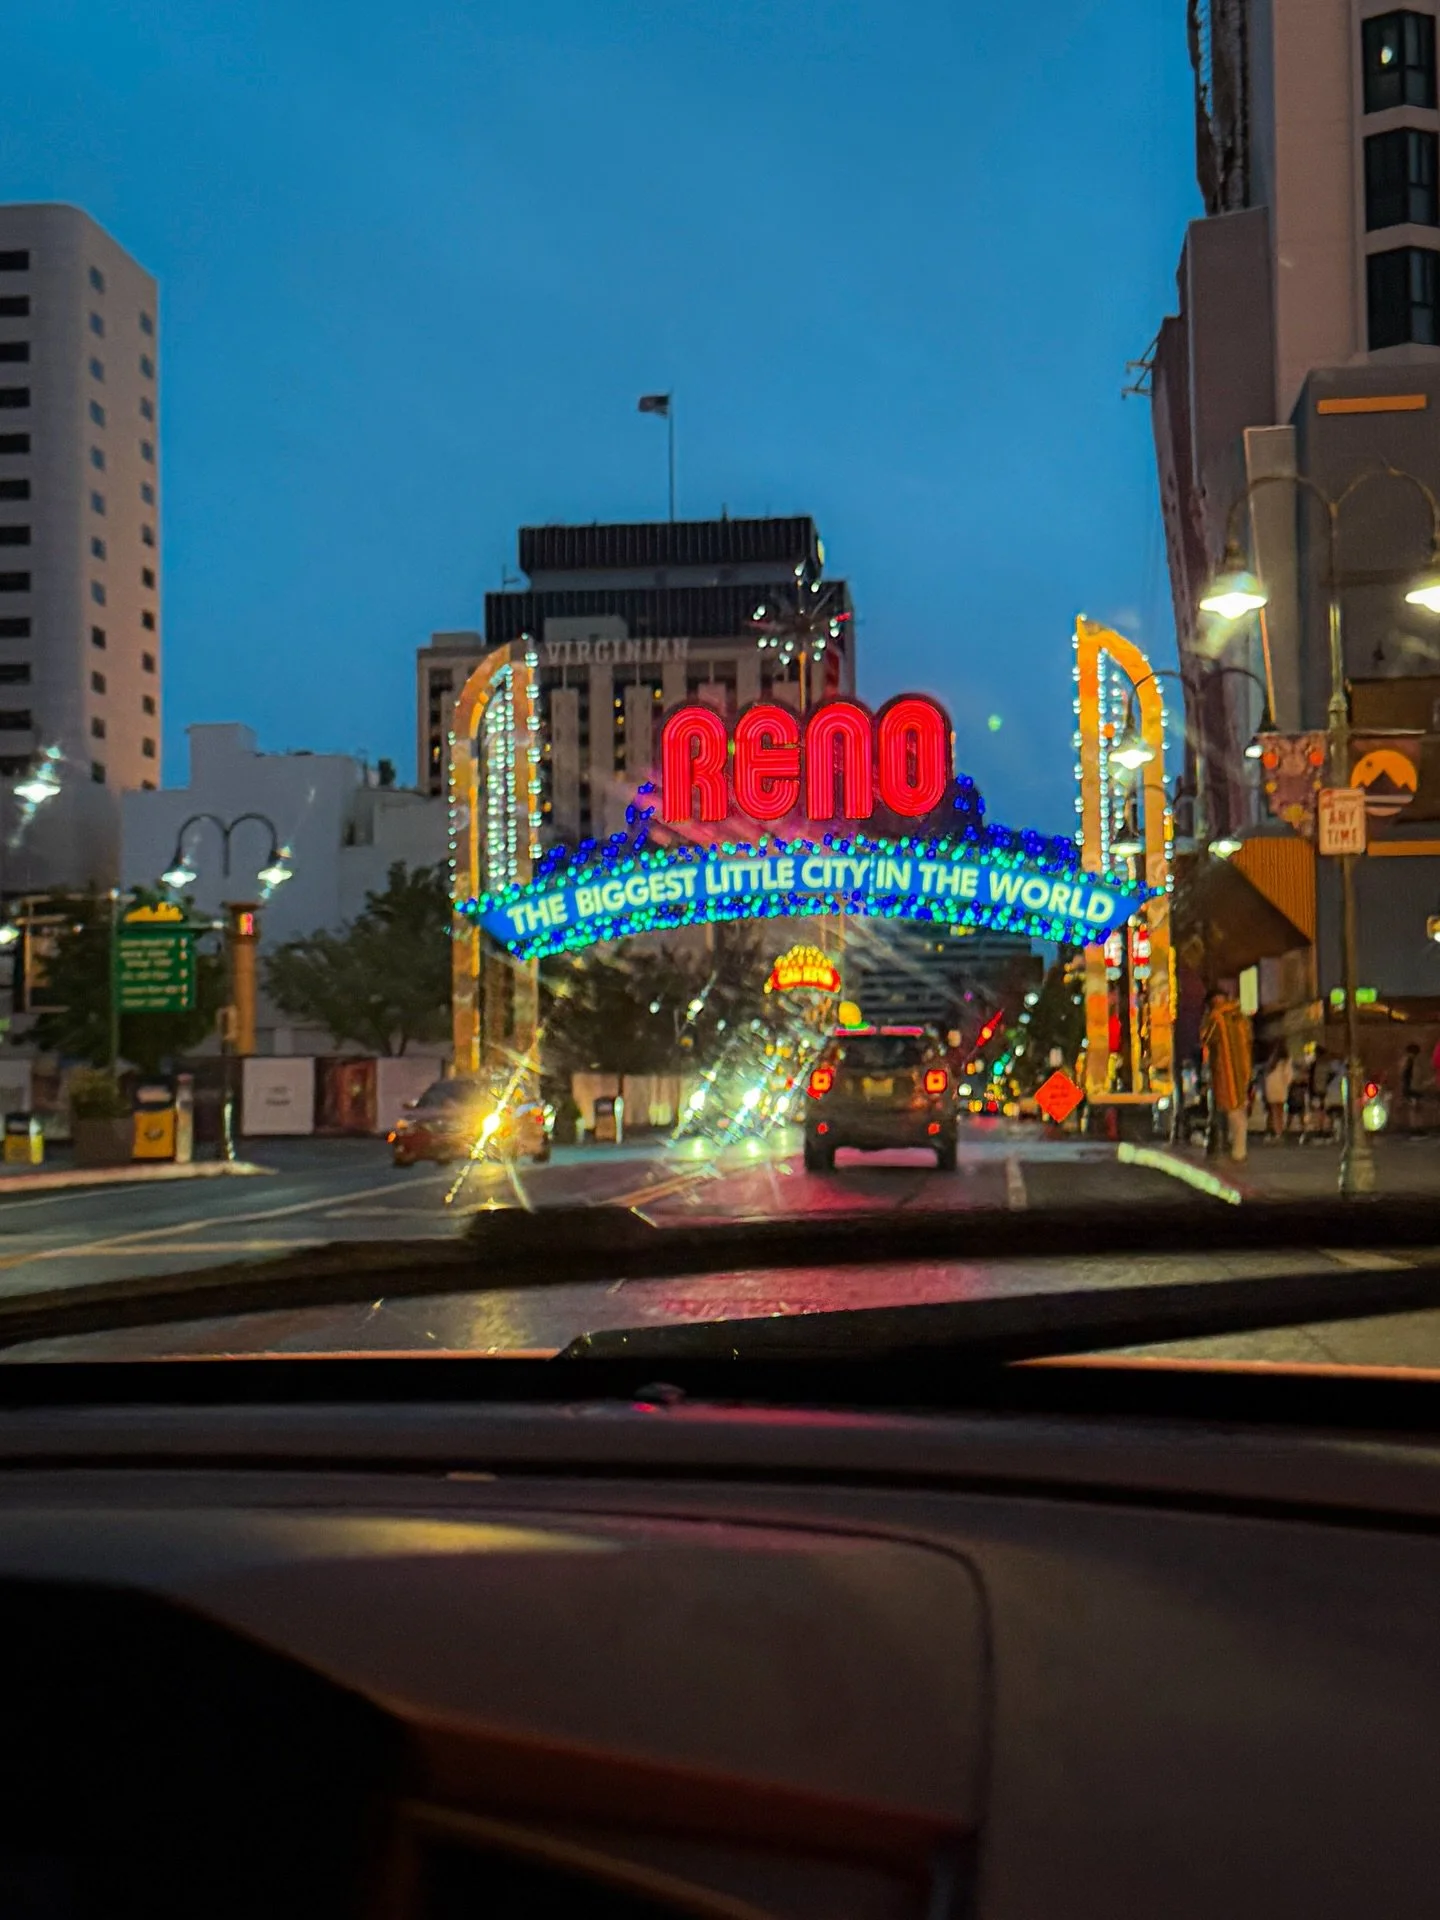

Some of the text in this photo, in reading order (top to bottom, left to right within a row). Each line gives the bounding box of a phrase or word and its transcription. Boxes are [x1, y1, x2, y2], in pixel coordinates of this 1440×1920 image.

[546, 637, 690, 666] VIRGINIAN
[662, 698, 947, 823] RENO
[1329, 809, 1356, 825] ANY
[1327, 828, 1357, 846] TIME
[507, 858, 1115, 935] THE BIGGEST LITTLE CITY IN THE WORLD
